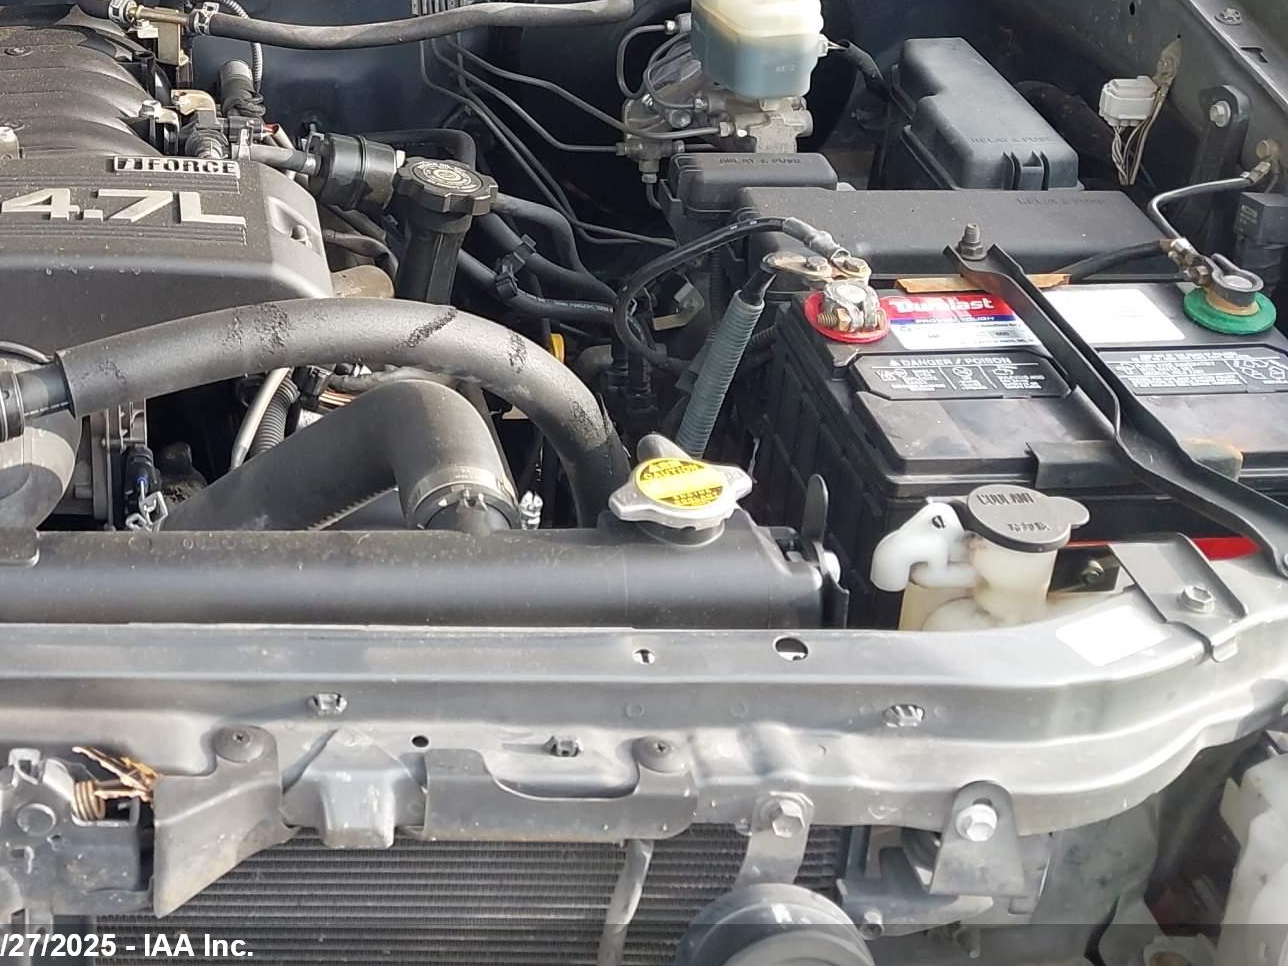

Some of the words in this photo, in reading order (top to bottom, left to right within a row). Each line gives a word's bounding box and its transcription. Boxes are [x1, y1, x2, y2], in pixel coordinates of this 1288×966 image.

[0, 187, 246, 224] 4.7L
[899, 358, 953, 367] DANGER
[964, 356, 1013, 366] POISON
[642, 464, 700, 481] CAUTION
[976, 492, 1035, 505] COOLANT
